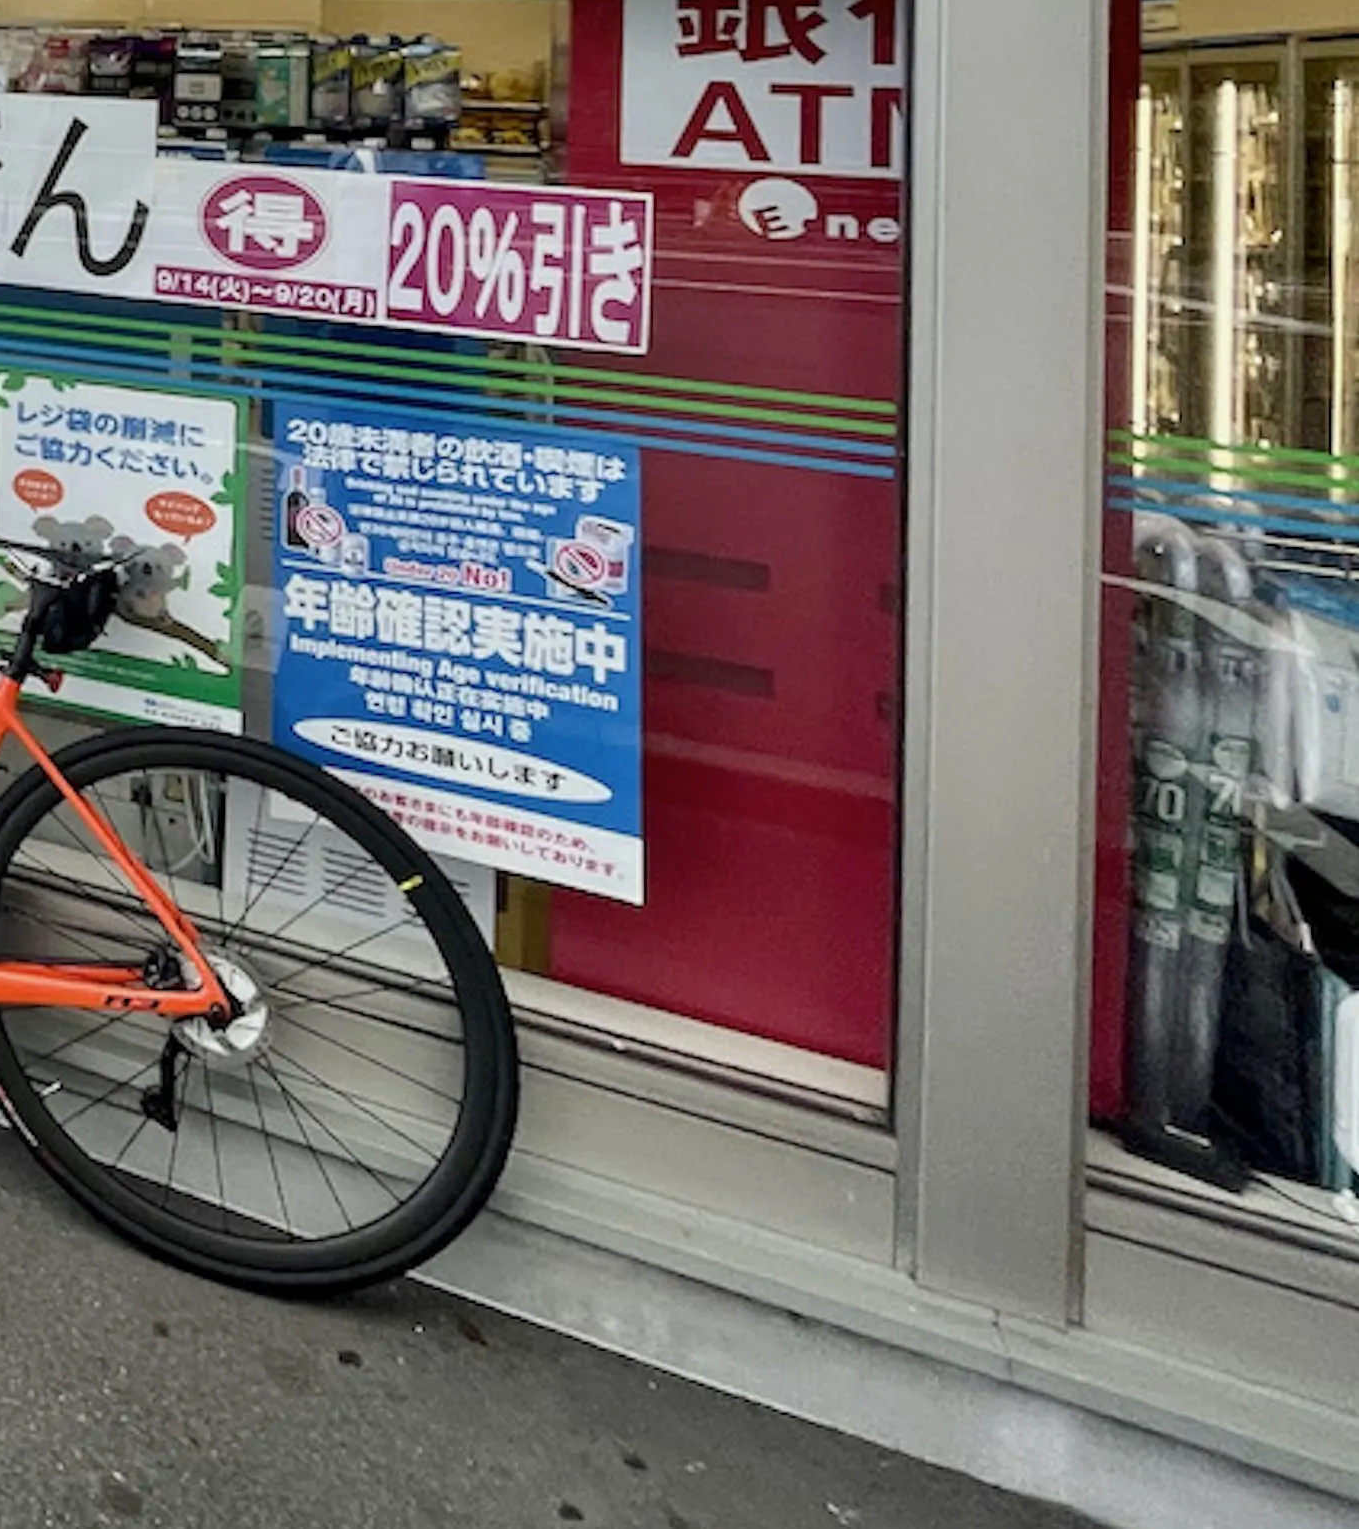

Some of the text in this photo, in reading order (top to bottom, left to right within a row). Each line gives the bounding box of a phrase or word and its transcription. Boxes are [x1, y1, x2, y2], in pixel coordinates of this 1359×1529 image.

[214, 190, 316, 258] 得
[389, 201, 645, 345] 20%引き
[17, 401, 205, 448] レジ袋の削減に
[15, 434, 213, 485] ご協力ください。
[463, 565, 511, 590] No!
[284, 574, 626, 683] 年齢確認実施中
[290, 634, 619, 712] Implementing Age verification
[331, 725, 568, 792] ご協力お願いします
